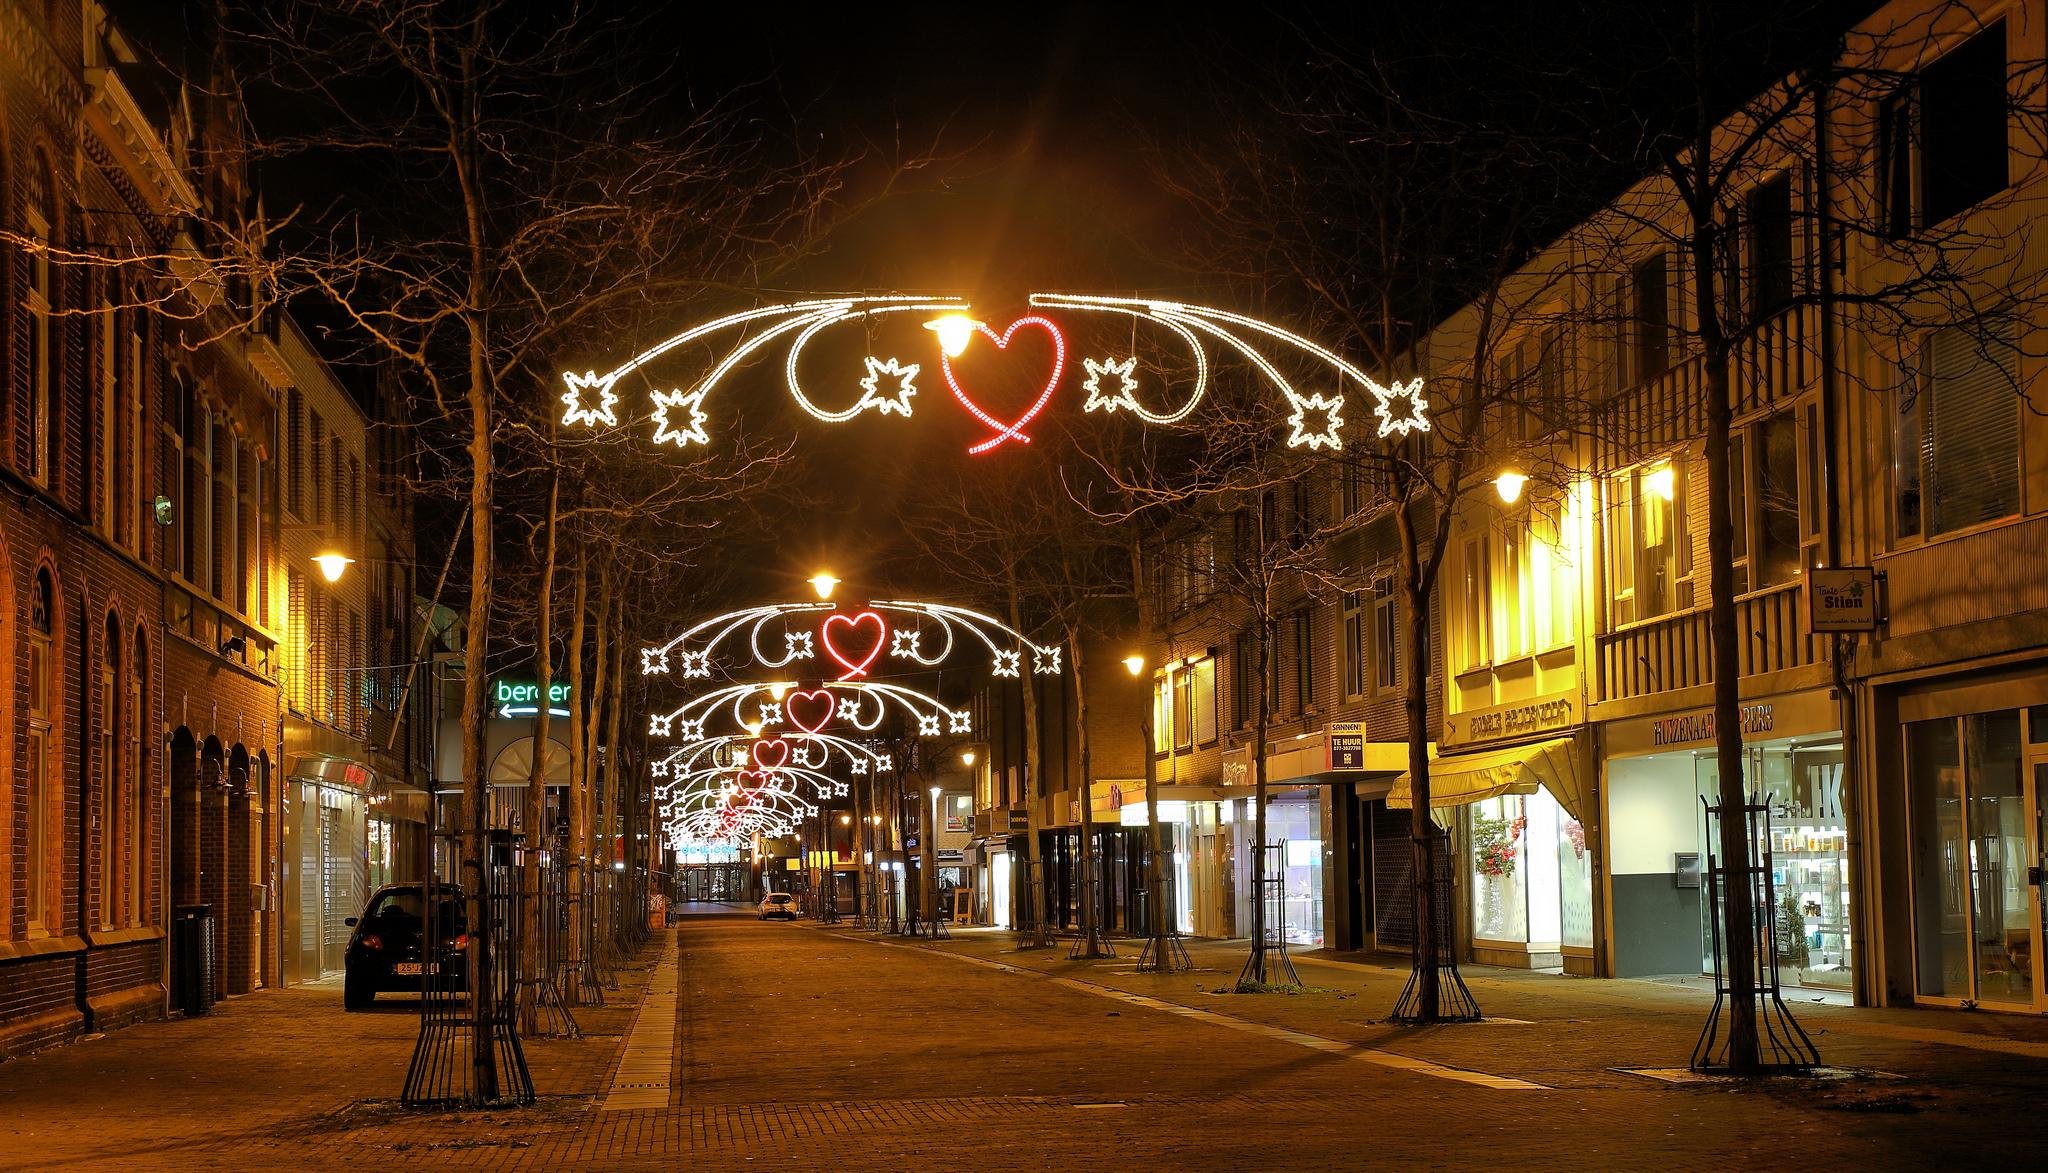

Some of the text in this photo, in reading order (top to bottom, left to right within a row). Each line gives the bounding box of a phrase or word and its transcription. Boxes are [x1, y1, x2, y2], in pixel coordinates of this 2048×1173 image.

[1824, 596, 1863, 608] Stien
[498, 680, 571, 701] berer
[1342, 738, 1362, 746] HUUR
